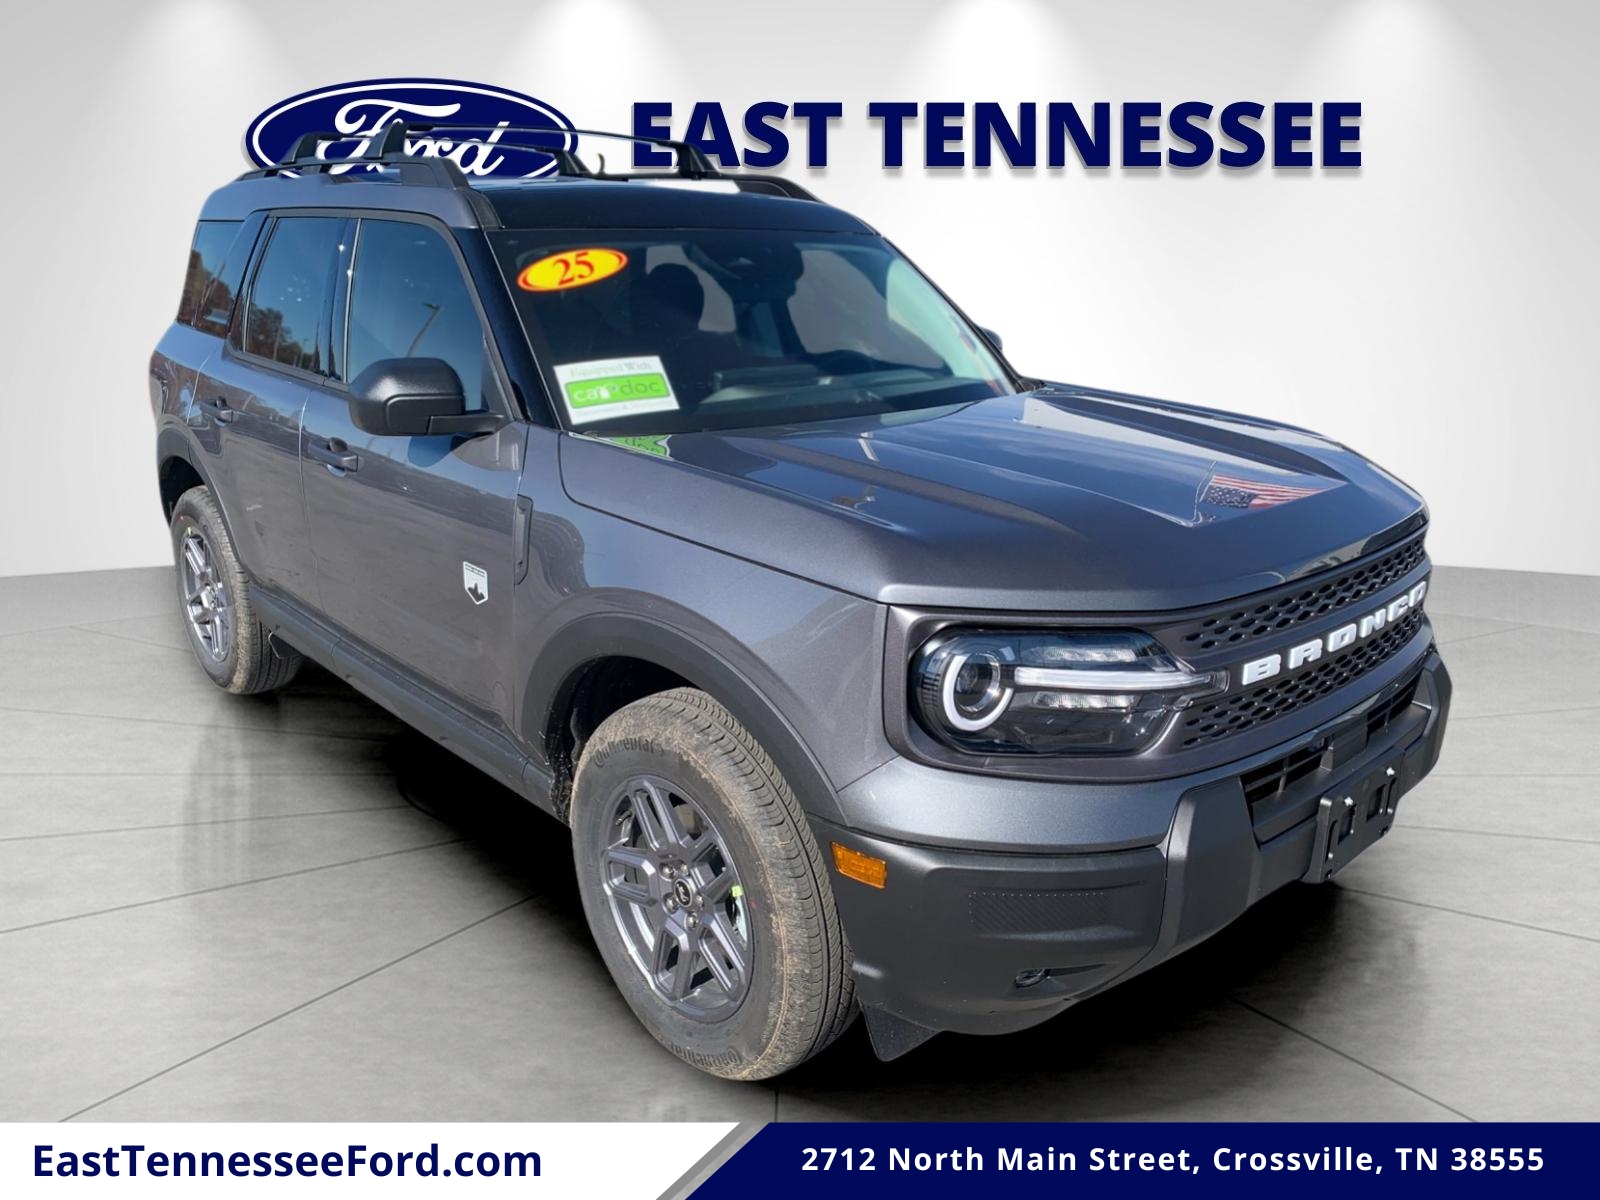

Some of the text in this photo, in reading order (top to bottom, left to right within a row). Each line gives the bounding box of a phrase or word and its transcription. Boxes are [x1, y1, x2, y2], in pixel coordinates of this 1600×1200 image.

[552, 251, 595, 286] 25
[620, 379, 661, 396] doc
[1241, 580, 1427, 686] BRONCO
